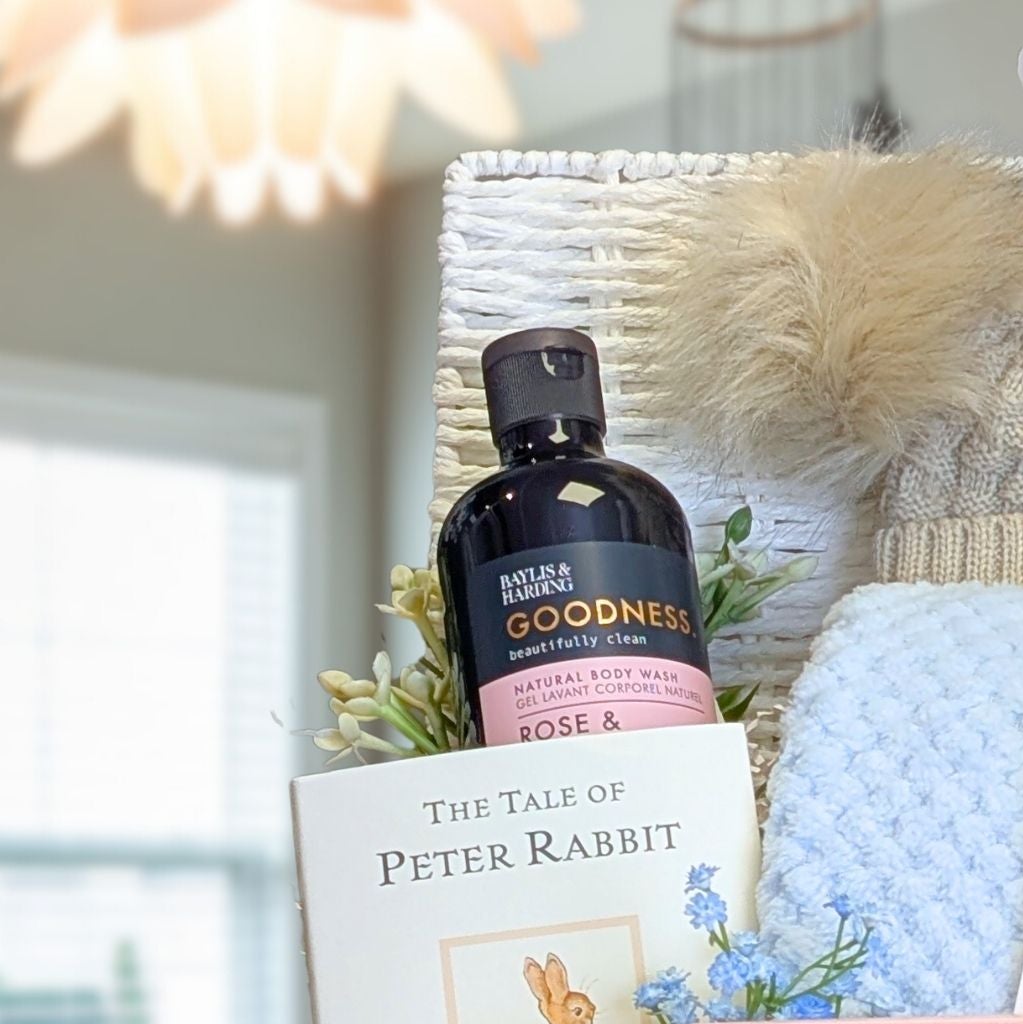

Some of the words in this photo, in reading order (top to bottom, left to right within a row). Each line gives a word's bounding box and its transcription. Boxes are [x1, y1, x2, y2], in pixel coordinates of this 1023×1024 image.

[500, 563, 556, 590] BAYLIS
[558, 562, 572, 577] &
[502, 577, 574, 606] HARDING
[509, 634, 598, 661] beautifully
[607, 633, 647, 645] clean
[514, 671, 583, 696] NATURAL
[591, 668, 632, 681] BODY
[639, 668, 678, 682] WASH
[516, 695, 538, 711] GEL
[543, 685, 589, 703] LAVANT
[595, 682, 662, 695] CORPOREL
[520, 713, 589, 743] ROSE
[603, 710, 621, 731] &
[376, 843, 515, 886] PETER
[524, 822, 681, 866] RABBIT
